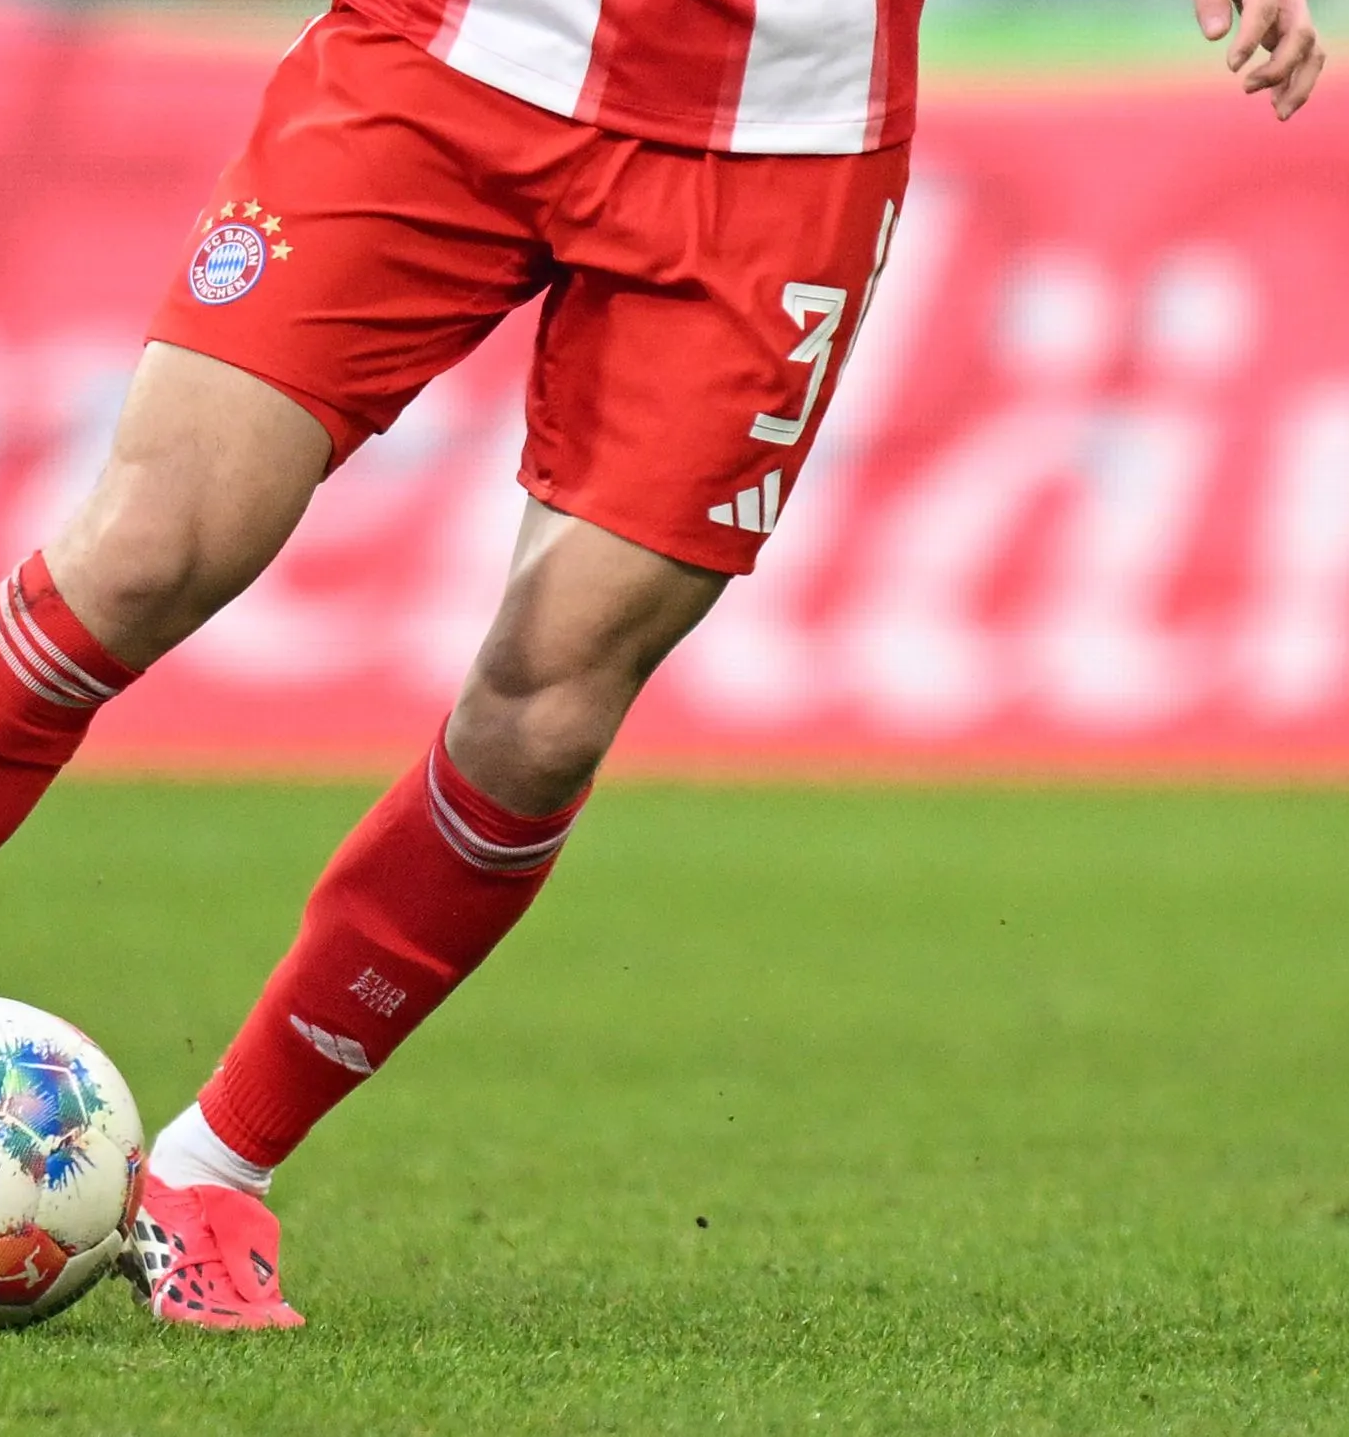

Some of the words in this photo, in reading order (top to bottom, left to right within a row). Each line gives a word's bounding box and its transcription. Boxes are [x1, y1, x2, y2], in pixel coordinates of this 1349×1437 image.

[204, 236, 222, 254] FC
[224, 229, 259, 266] BAYERN
[749, 281, 848, 446] 3
